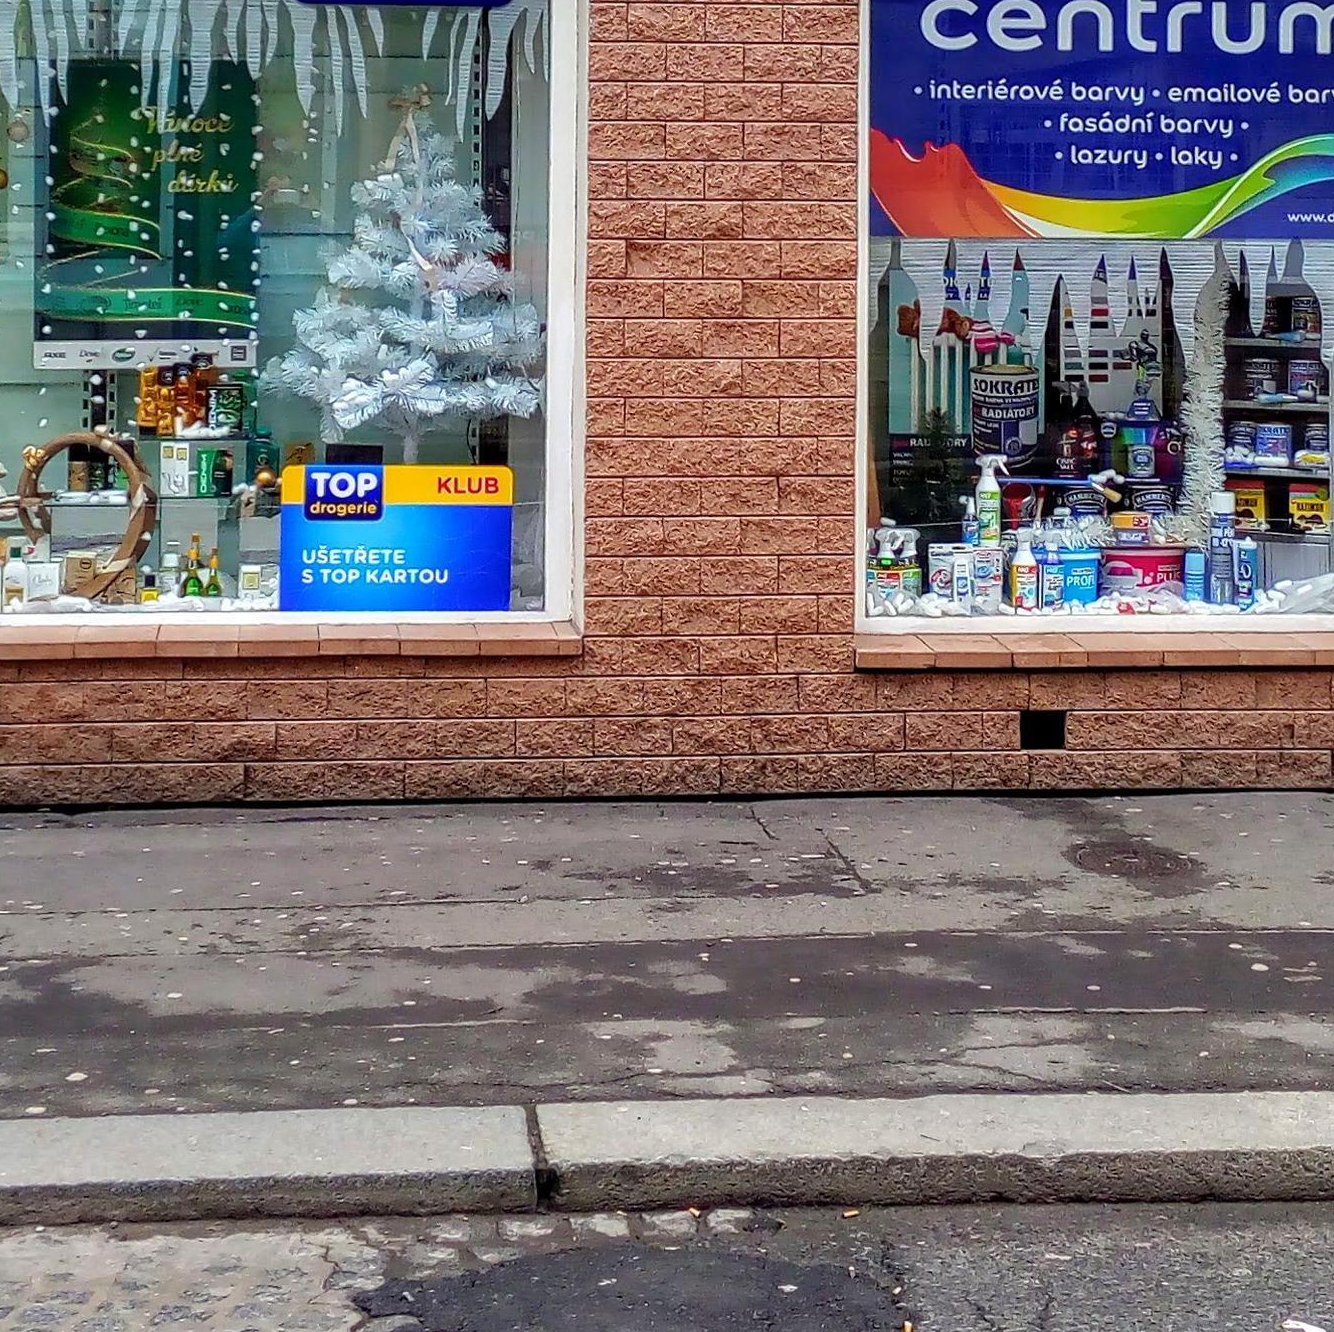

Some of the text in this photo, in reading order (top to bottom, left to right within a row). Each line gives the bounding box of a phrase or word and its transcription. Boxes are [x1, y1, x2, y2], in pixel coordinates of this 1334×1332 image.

[929, 78, 1064, 100] interiérové
[1071, 80, 1146, 105] barvy
[1167, 81, 1282, 104] emailové
[1059, 111, 1233, 137] fasádní barvy
[1070, 145, 1223, 169] lazury laky
[974, 378, 1039, 395] SOKRATE
[310, 472, 500, 499] TOP KLUB
[309, 500, 377, 517] drogerie
[302, 545, 406, 565] UŠETŘETE
[301, 568, 449, 584] S TOP KARTOU
